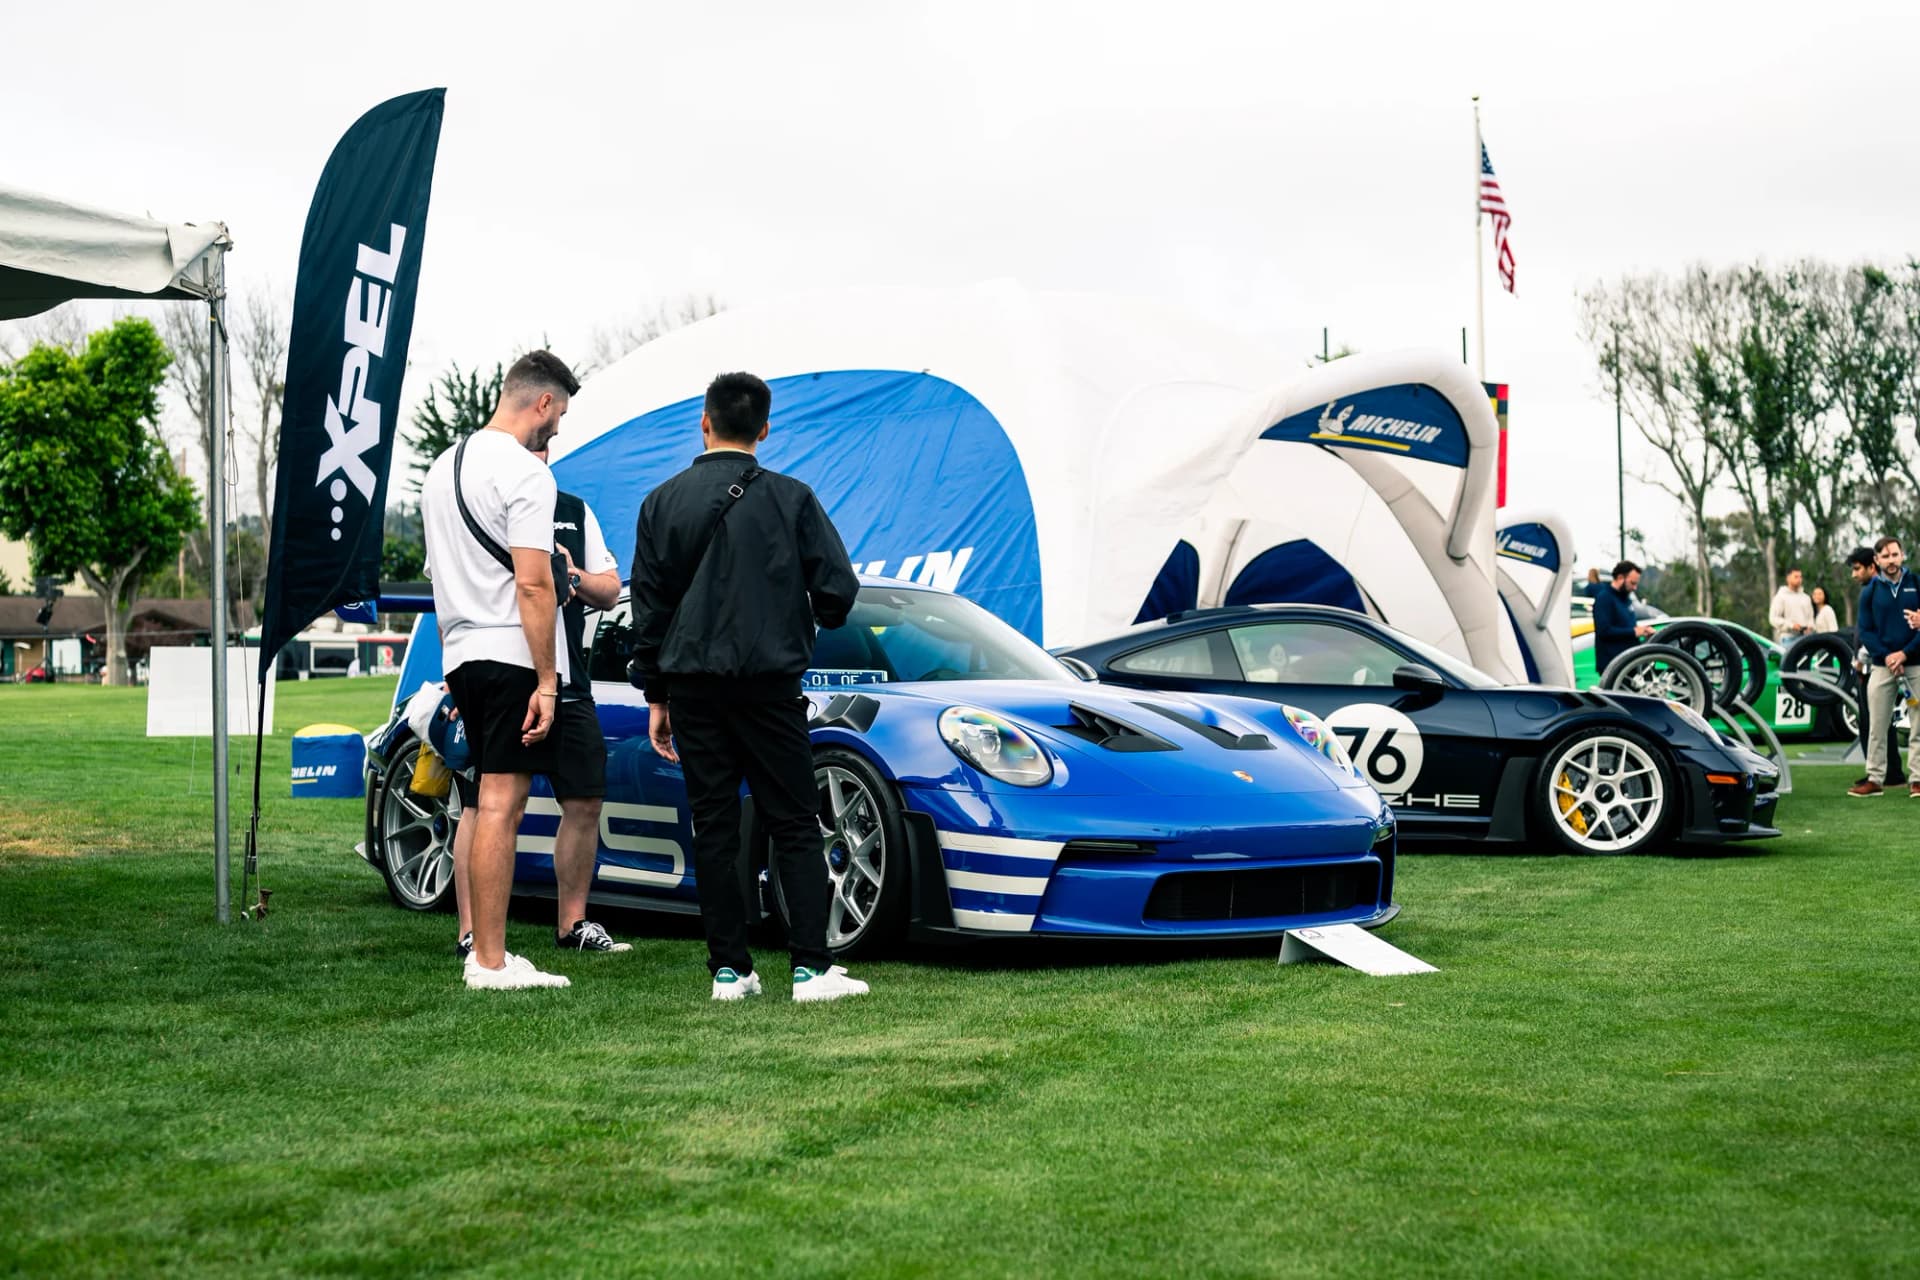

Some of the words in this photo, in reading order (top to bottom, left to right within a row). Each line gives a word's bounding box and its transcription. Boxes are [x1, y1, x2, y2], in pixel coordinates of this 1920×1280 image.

[315, 223, 407, 507] XPEL
[1348, 414, 1442, 443] MICHELIN
[1782, 697, 1805, 719] 28
[1332, 727, 1406, 784] 76
